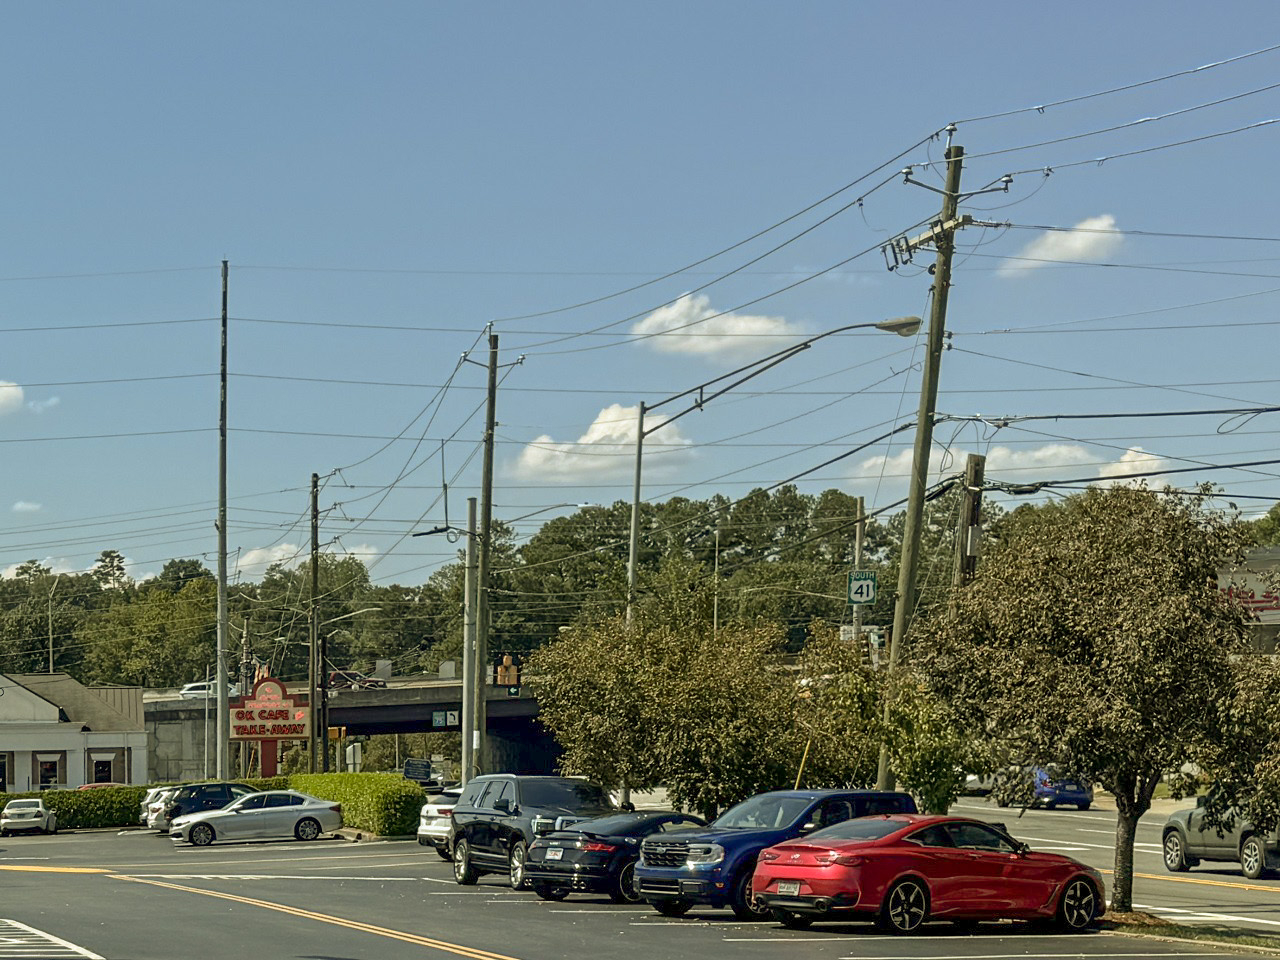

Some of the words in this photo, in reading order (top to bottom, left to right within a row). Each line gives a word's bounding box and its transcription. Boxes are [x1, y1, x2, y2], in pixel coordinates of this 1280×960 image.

[854, 584, 869, 598] 41
[235, 710, 255, 721] OK
[258, 709, 290, 721] CAFE
